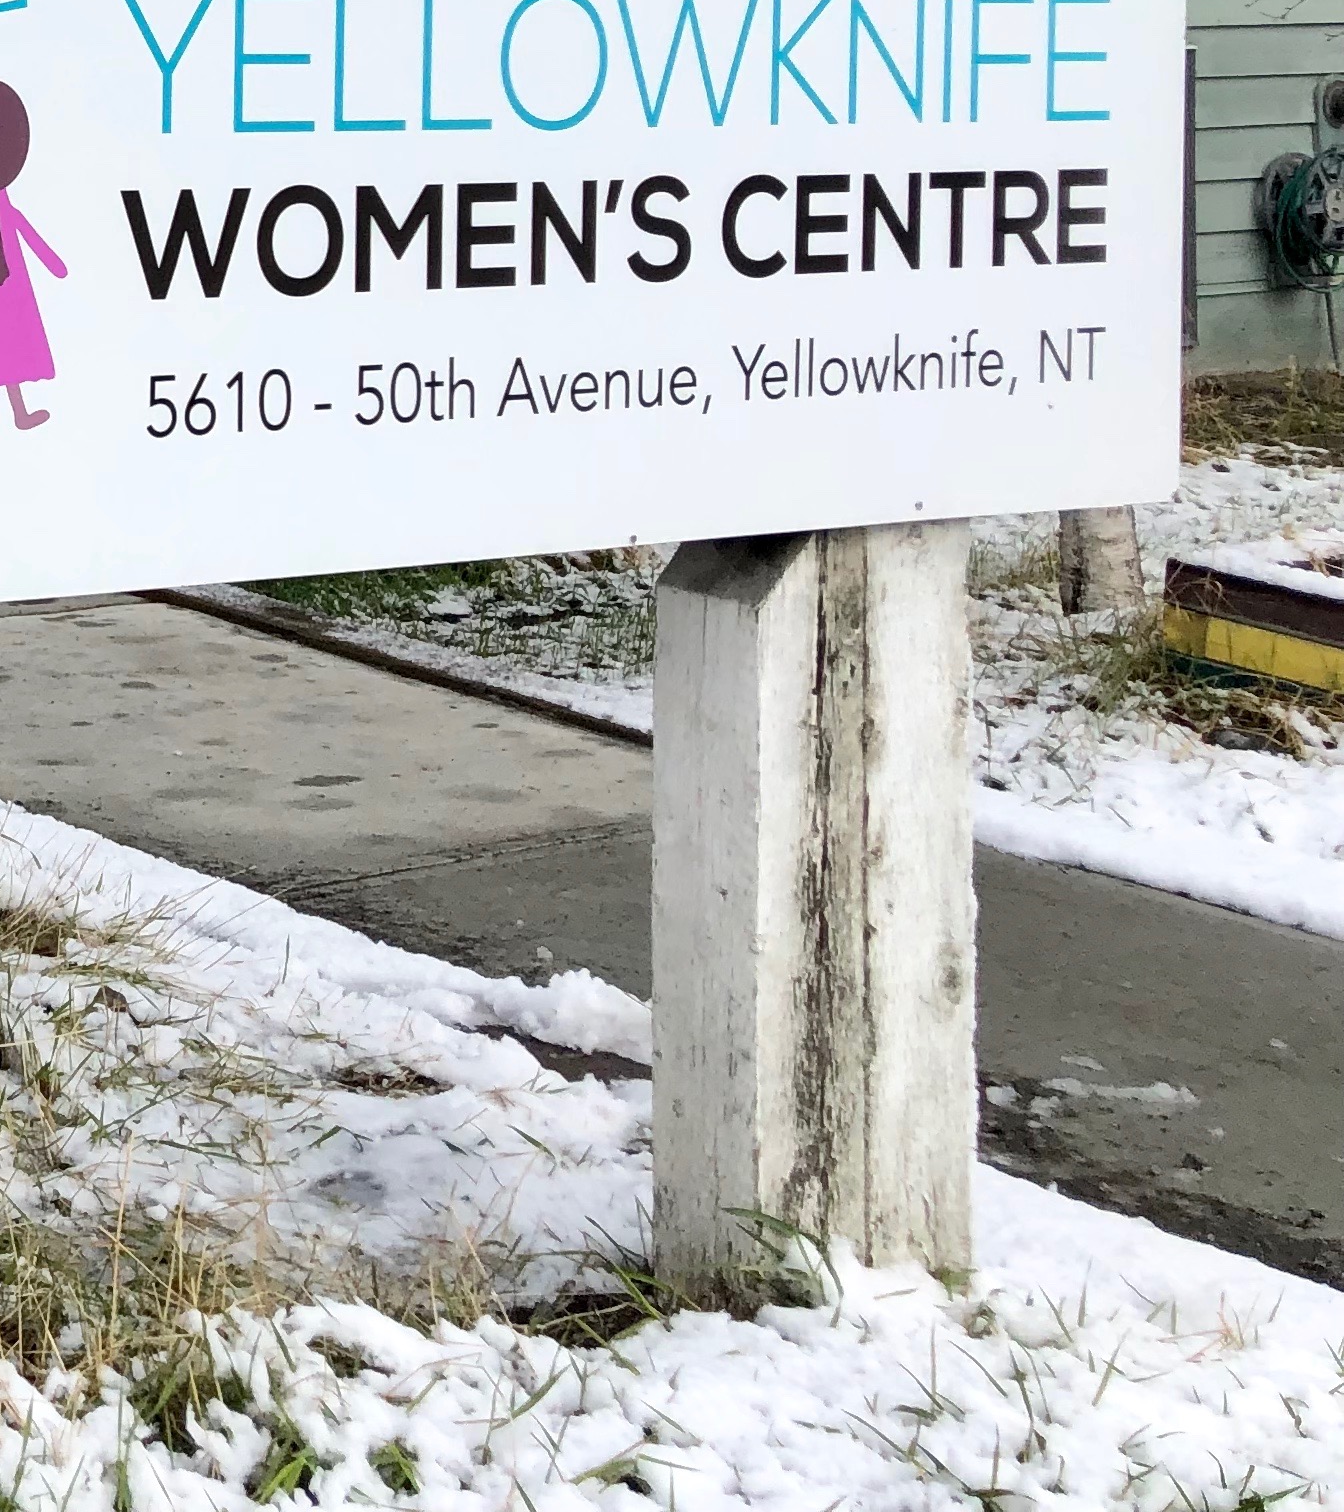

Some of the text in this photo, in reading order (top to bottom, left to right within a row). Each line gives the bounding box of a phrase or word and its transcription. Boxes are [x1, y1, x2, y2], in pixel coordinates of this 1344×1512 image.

[119, 168, 1108, 301] WOMEN'S CENTRE
[146, 368, 292, 439] 5610
[354, 356, 475, 426] 50th
[496, 356, 712, 417] Avenue,
[731, 328, 1018, 401] Yellowknife,
[1039, 326, 1106, 384] NT
